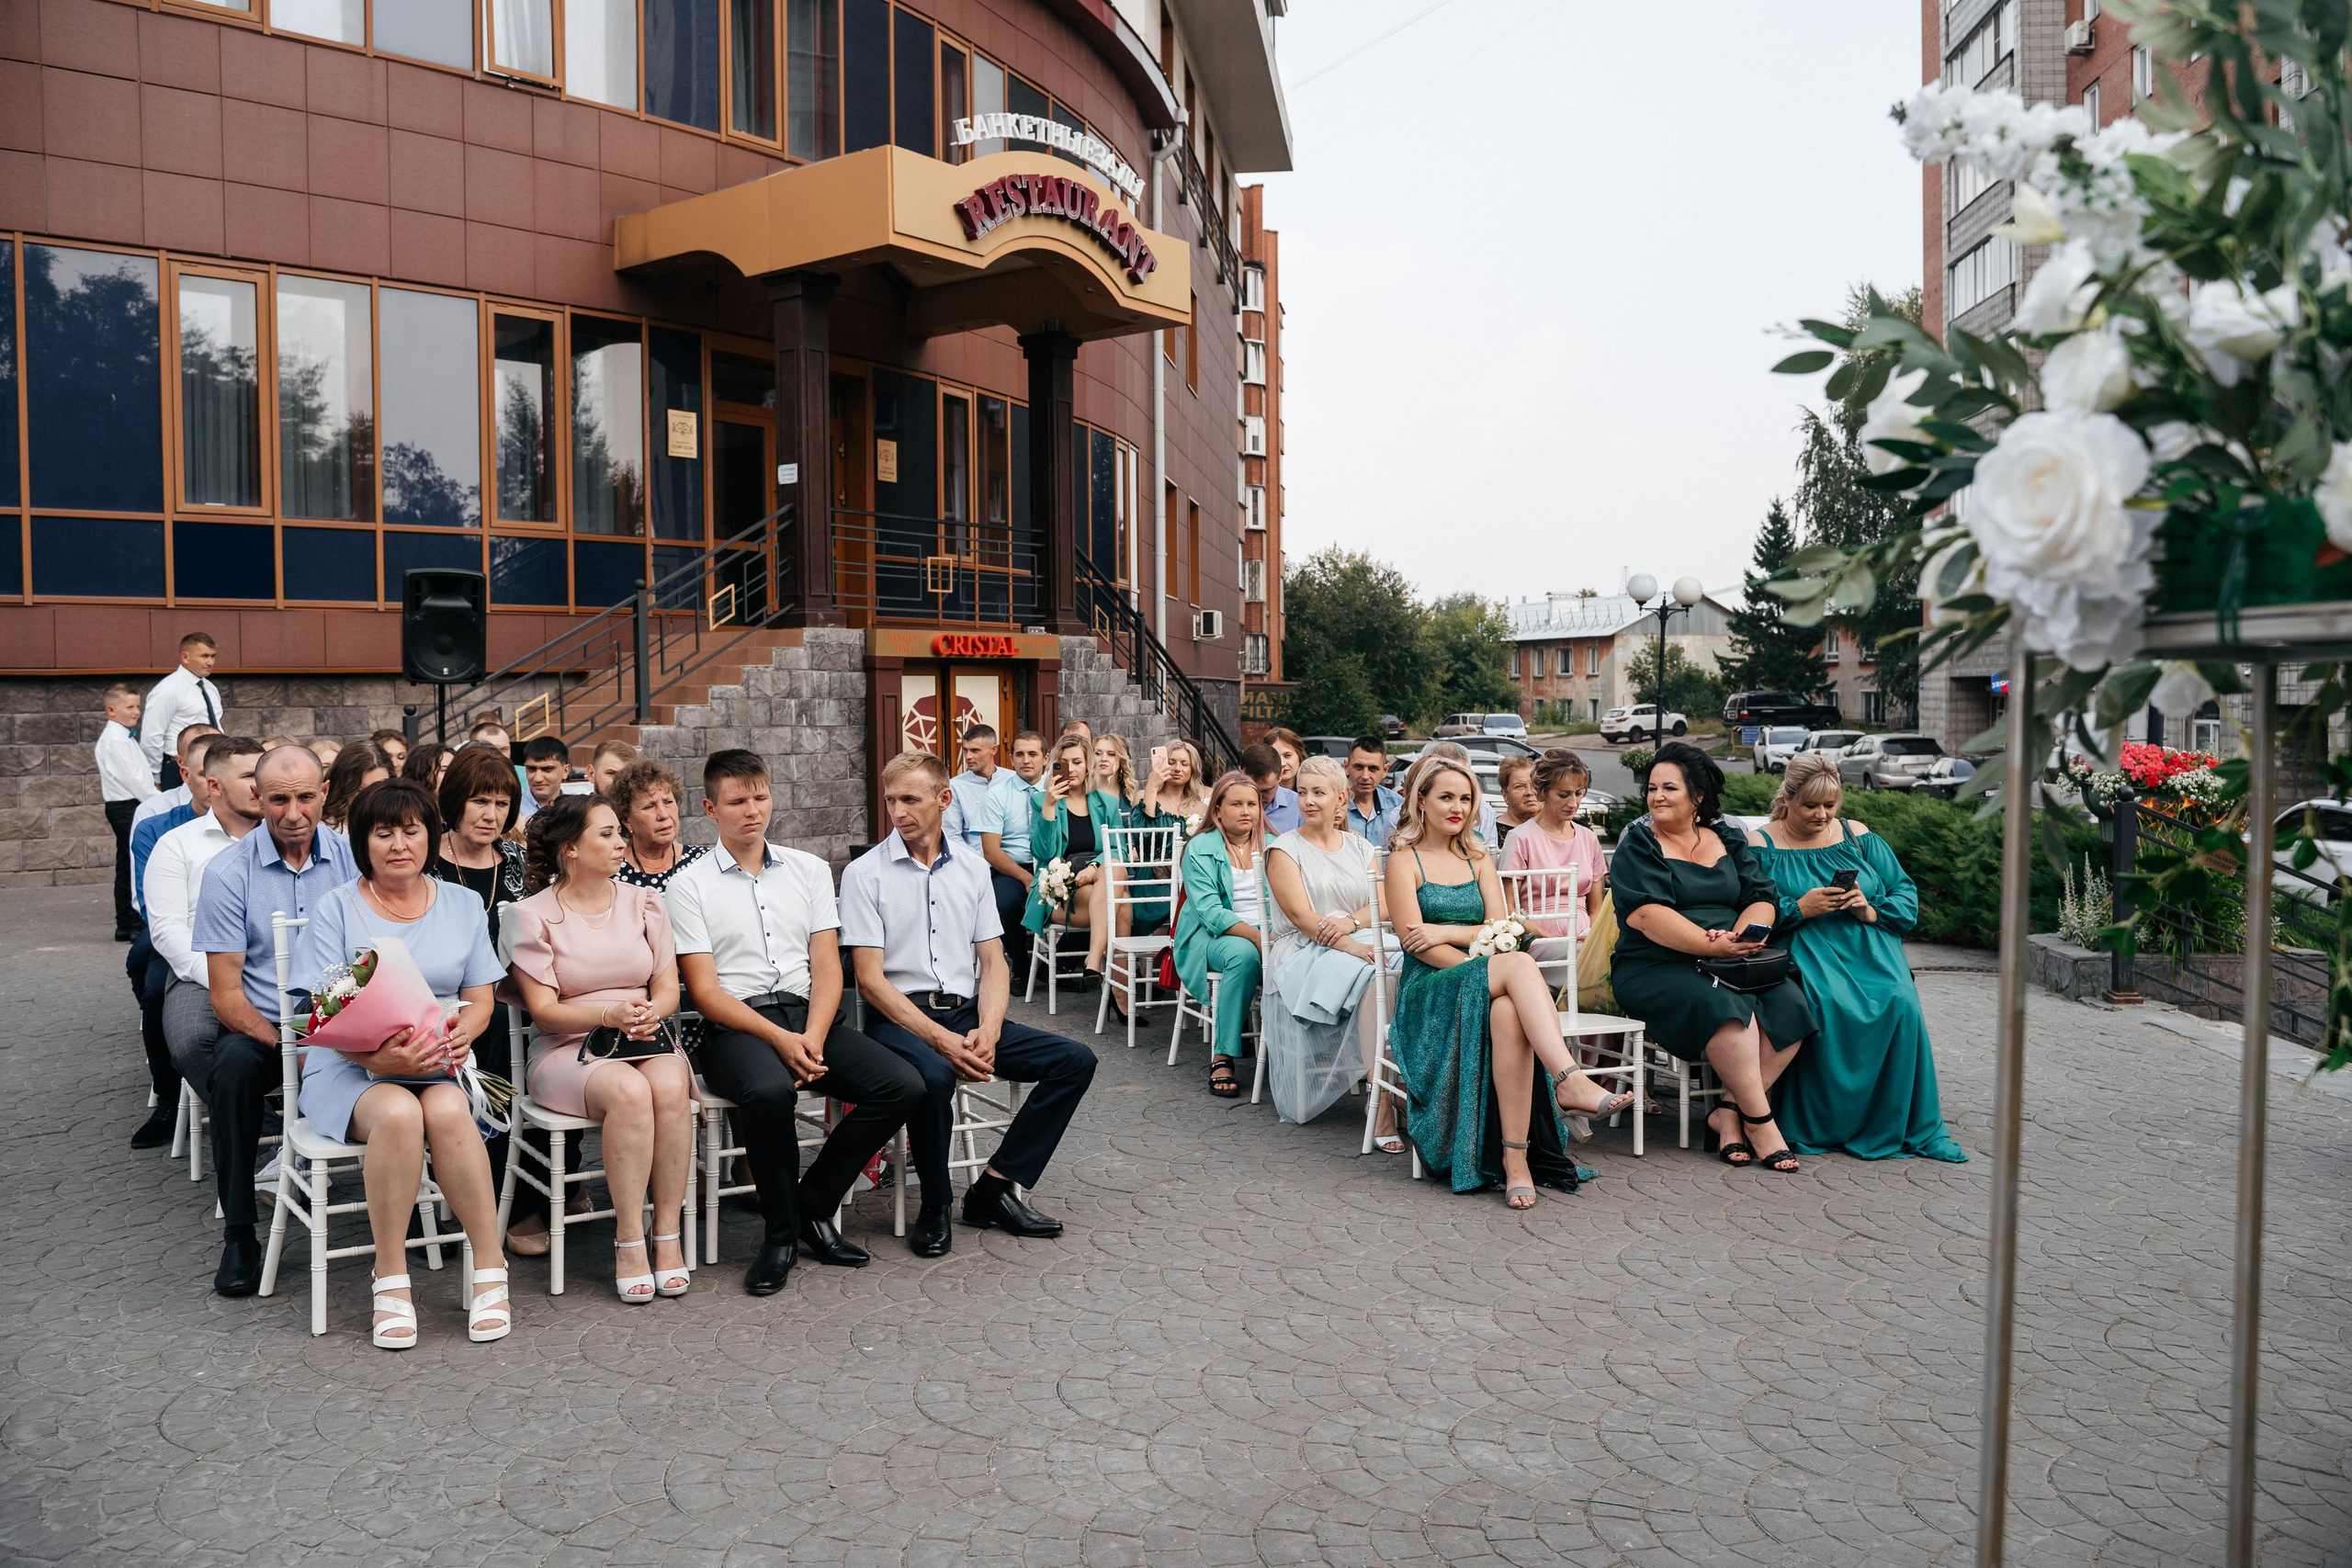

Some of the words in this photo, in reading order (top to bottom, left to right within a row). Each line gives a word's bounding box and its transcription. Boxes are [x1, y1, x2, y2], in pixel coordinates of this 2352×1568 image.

[955, 173, 1158, 285] RESTAURANT
[887, 634, 923, 645] BANQUET
[933, 633, 1021, 656] CRISTAL
[895, 644, 915, 653] HALL
[2205, 857, 2232, 870] ТУПЕНИ
